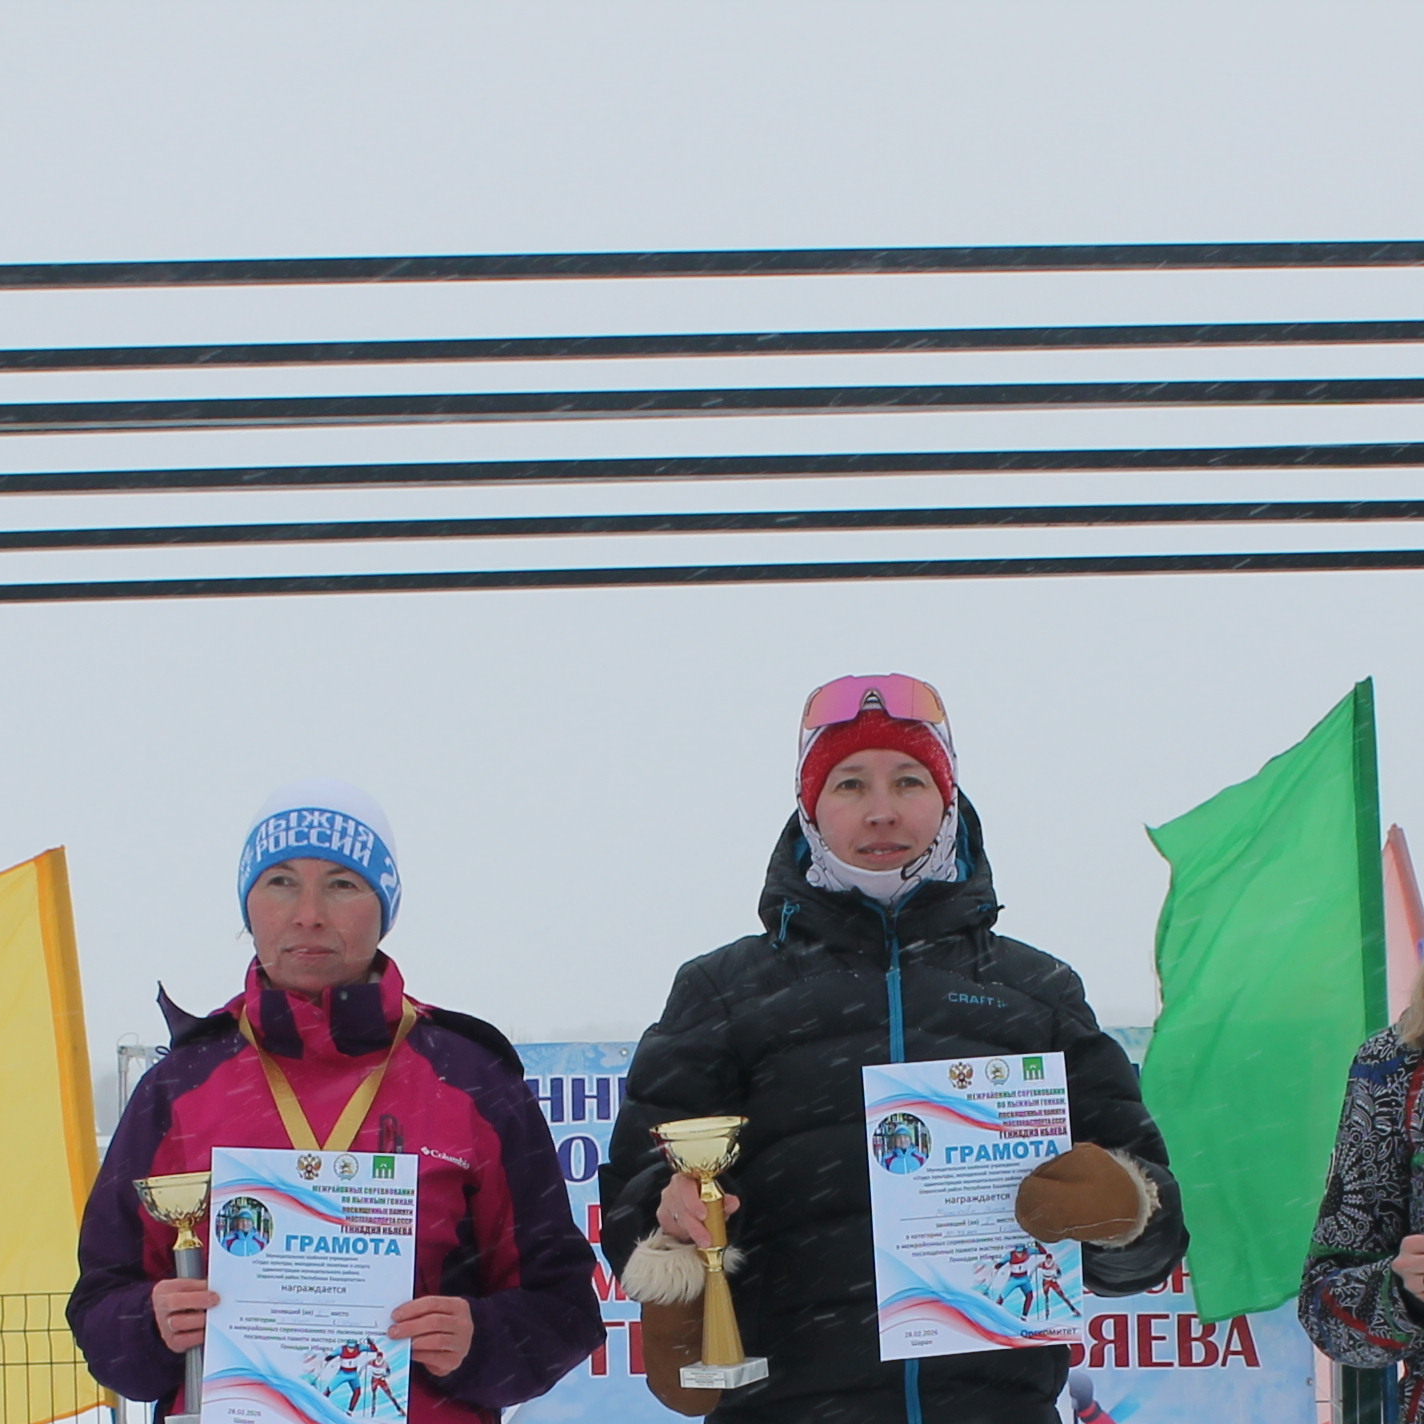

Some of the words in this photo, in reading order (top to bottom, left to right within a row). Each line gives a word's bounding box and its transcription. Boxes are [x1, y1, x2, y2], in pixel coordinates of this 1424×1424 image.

[256, 810, 375, 850] ЛЫЖНЯ
[256, 827, 374, 867] РОССИИ
[948, 992, 994, 1006] CRAFT
[944, 1140, 1060, 1164] ГРАМОТА
[945, 1191, 1010, 1204] награждается
[285, 1234, 401, 1256] ГРАМОТА
[281, 1283, 346, 1293] награждается
